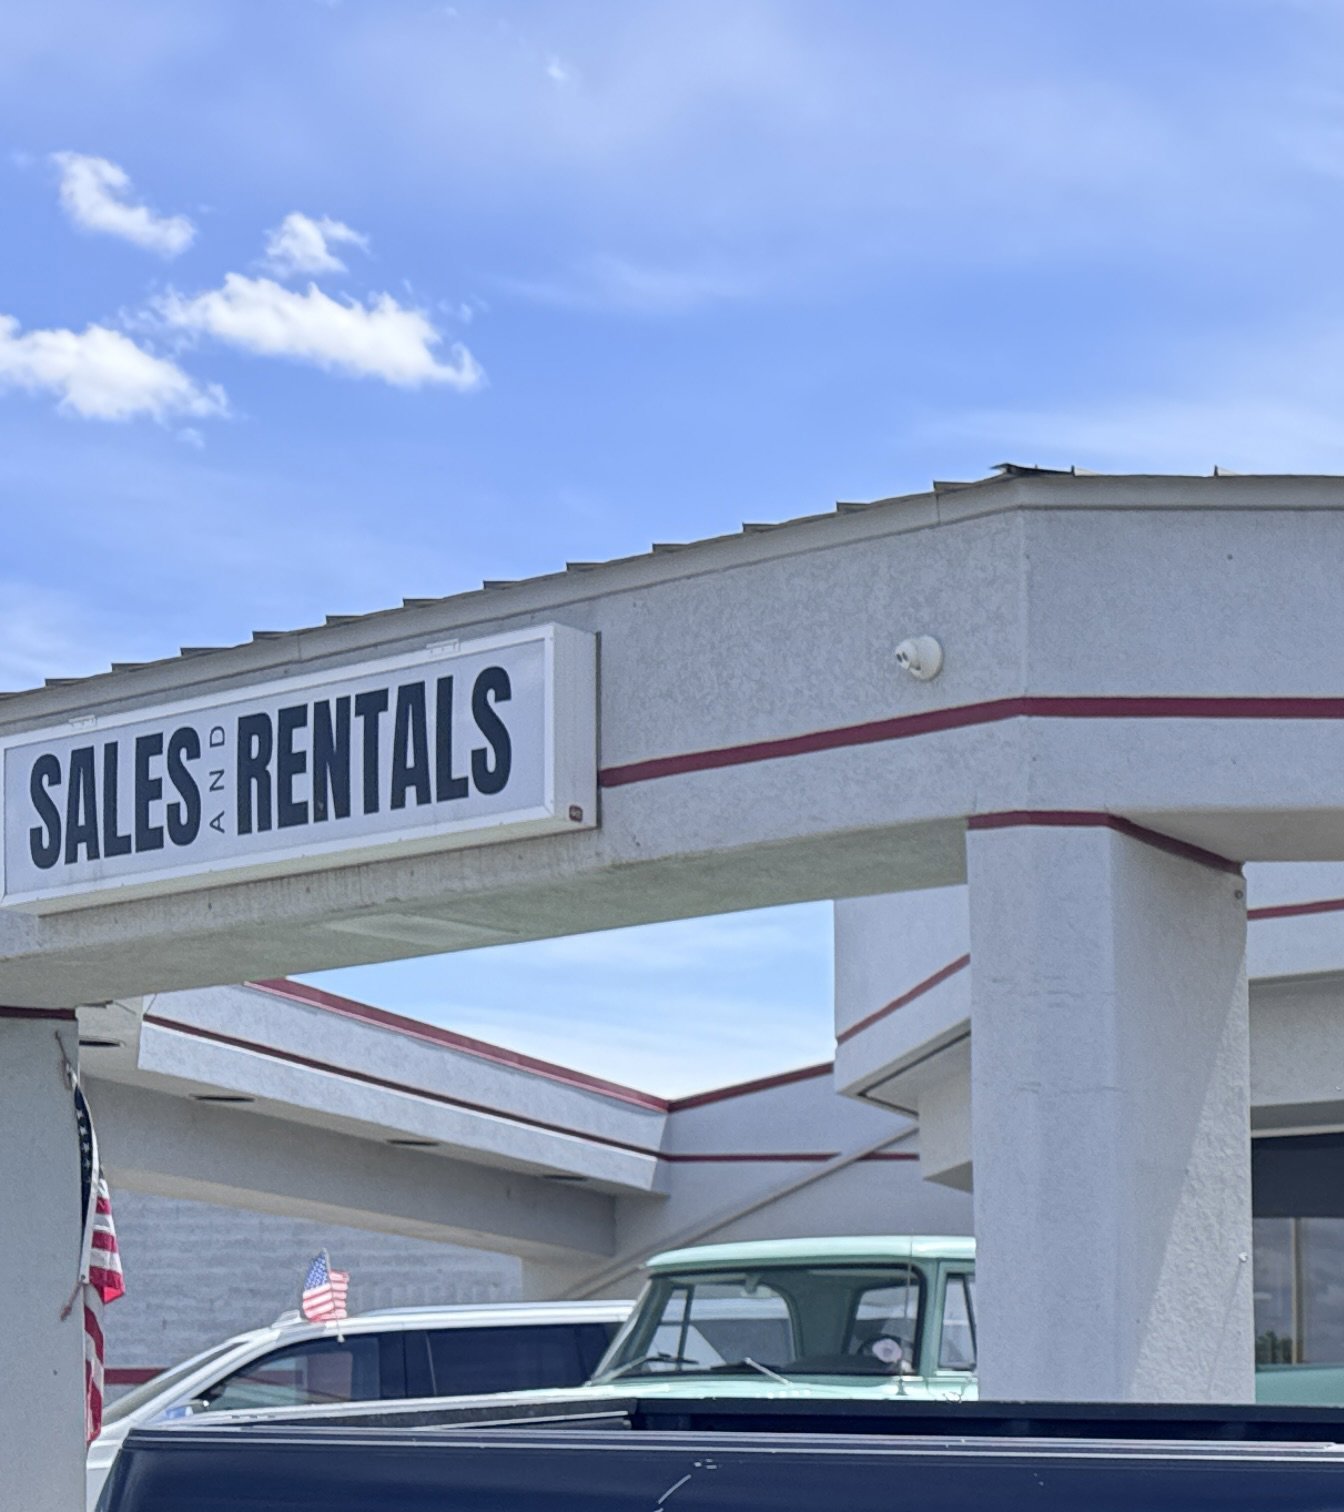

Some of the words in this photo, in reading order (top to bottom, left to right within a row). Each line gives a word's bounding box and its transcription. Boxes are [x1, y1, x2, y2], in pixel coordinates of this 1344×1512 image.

[29, 725, 202, 870] SALES
[209, 724, 226, 833] AND
[236, 665, 513, 835] RENTALS
